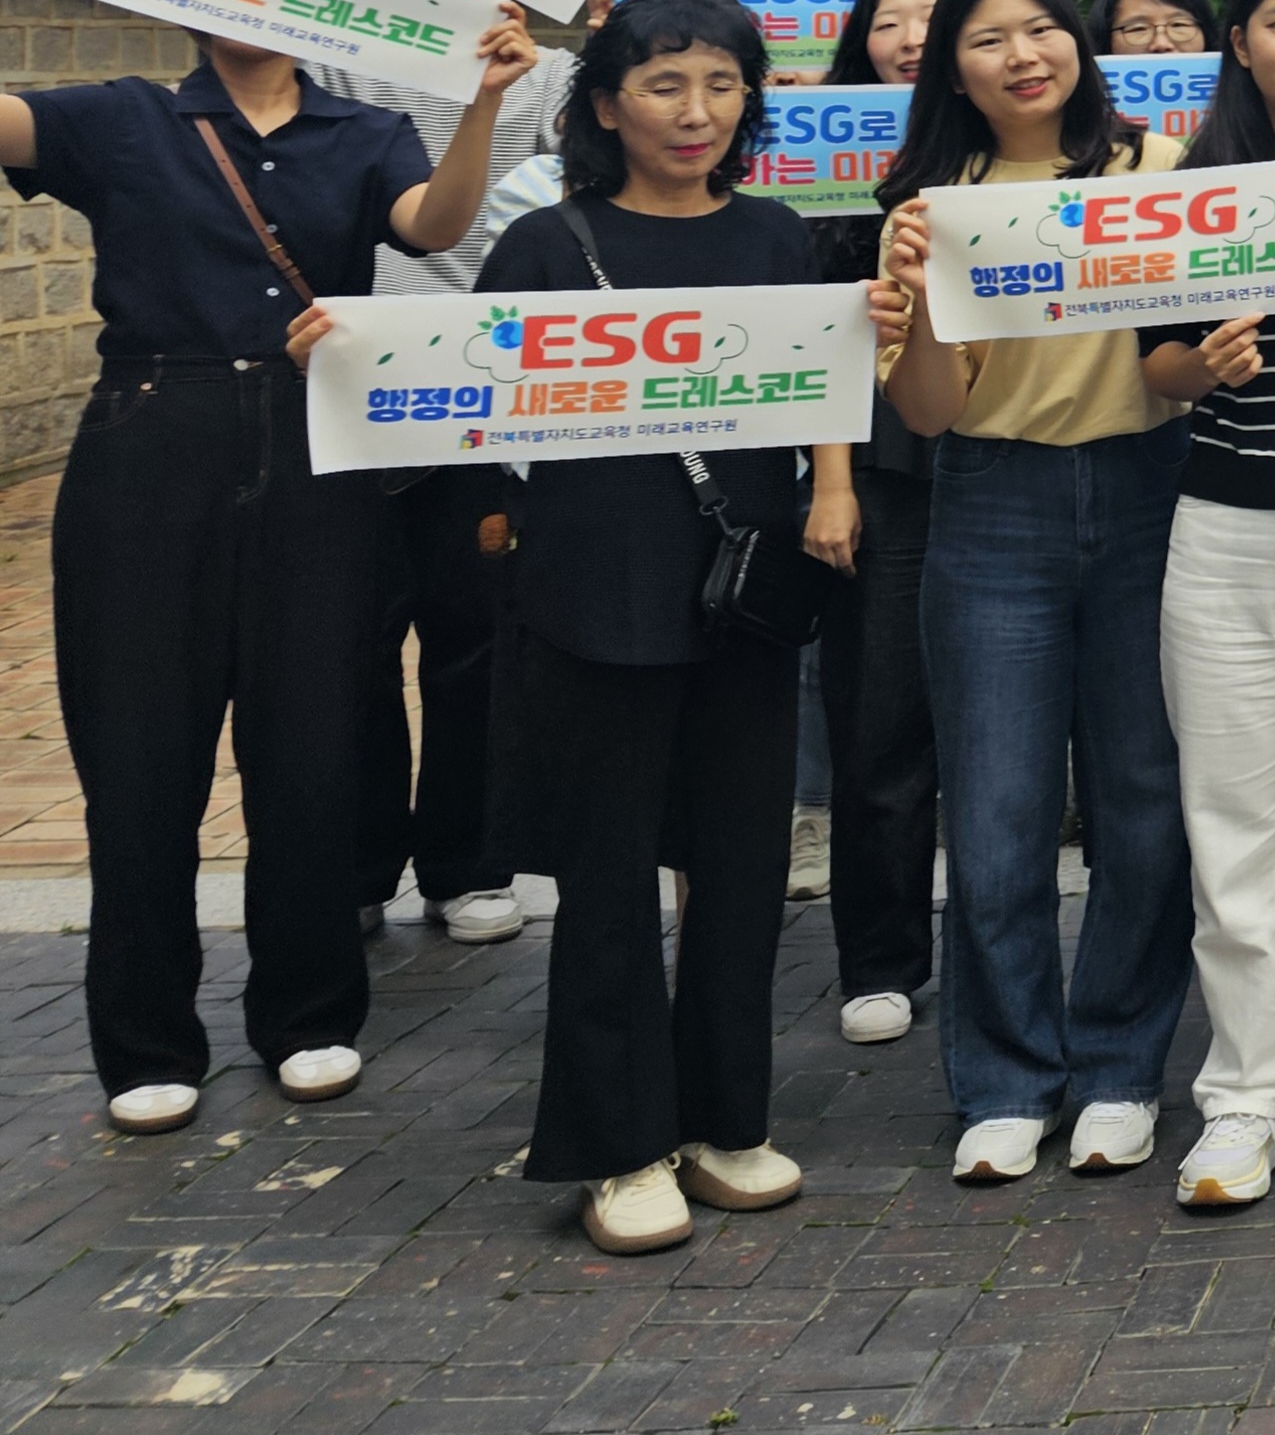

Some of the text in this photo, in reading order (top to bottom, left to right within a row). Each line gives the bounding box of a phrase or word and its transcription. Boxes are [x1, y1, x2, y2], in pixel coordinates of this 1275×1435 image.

[268, 20, 361, 55] 미래교육연구원
[1083, 187, 1237, 244] ESG
[971, 262, 1063, 297] 행정의
[1078, 252, 1175, 289] 새로운
[1065, 285, 1275, 317] 전북특별자치도교육청 미래교육연구원
[521, 311, 701, 369] ESG
[368, 370, 825, 422] 행정의 새로운 드레스코드
[487, 418, 737, 446] 전북특별자치도교육청 미래교육연구원
[679, 450, 711, 484] OUNG
